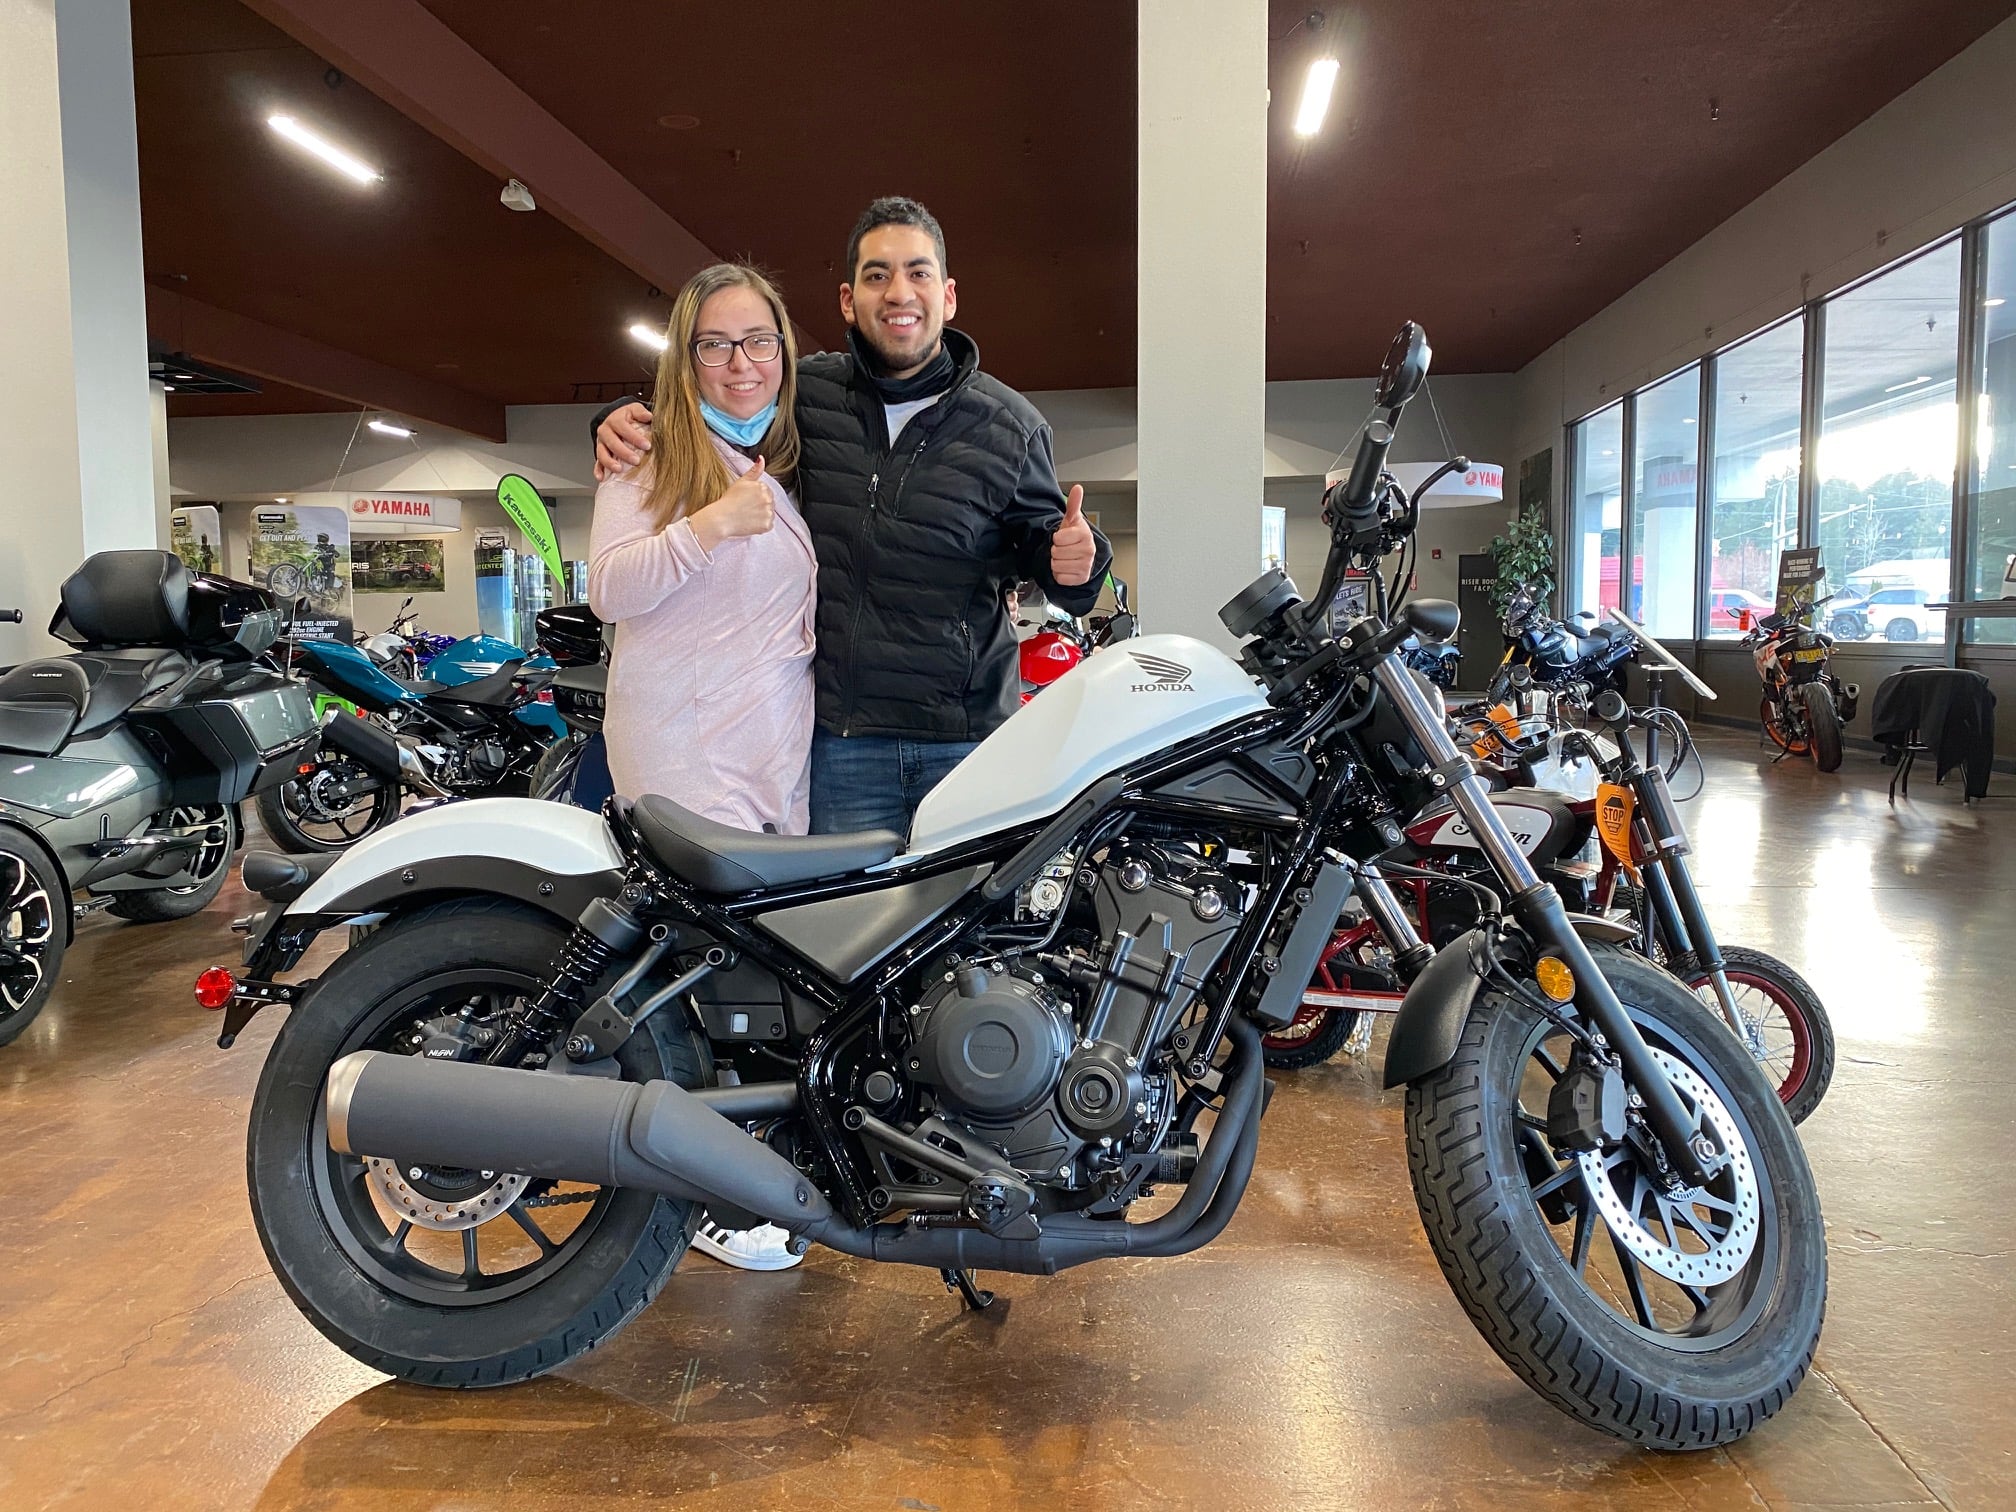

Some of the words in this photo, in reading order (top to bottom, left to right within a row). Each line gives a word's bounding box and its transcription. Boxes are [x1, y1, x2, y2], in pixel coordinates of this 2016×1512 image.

[371, 500, 431, 517] YAMAHA
[503, 493, 551, 554] Kawasaki
[1350, 585, 1363, 596] RIDE
[1131, 683, 1195, 693] HONDA
[1602, 807, 1624, 822] STOP
